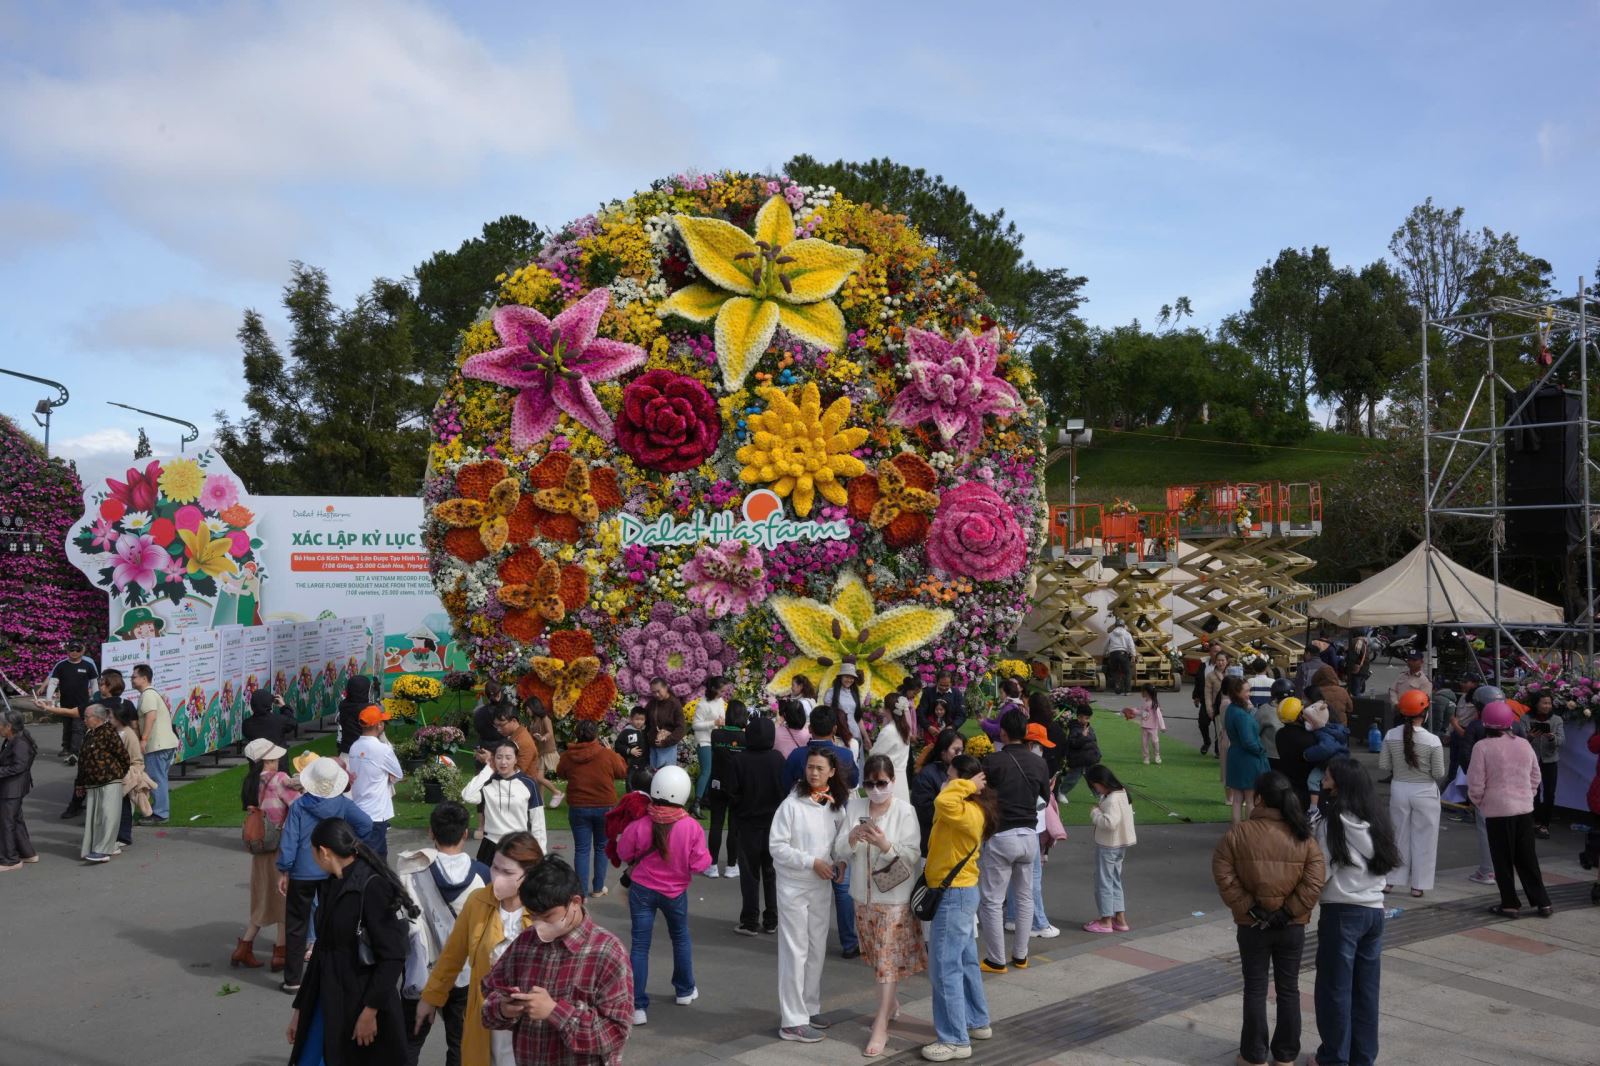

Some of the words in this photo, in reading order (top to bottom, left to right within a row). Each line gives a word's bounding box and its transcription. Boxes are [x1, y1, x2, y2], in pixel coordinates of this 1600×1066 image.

[291, 530, 323, 546] XÁC
[327, 530, 358, 550] LẬP
[361, 529, 382, 546] KỶ
[385, 533, 416, 550] LỤC
[621, 512, 705, 546] Dalat
[710, 511, 847, 547] Hasfarm
